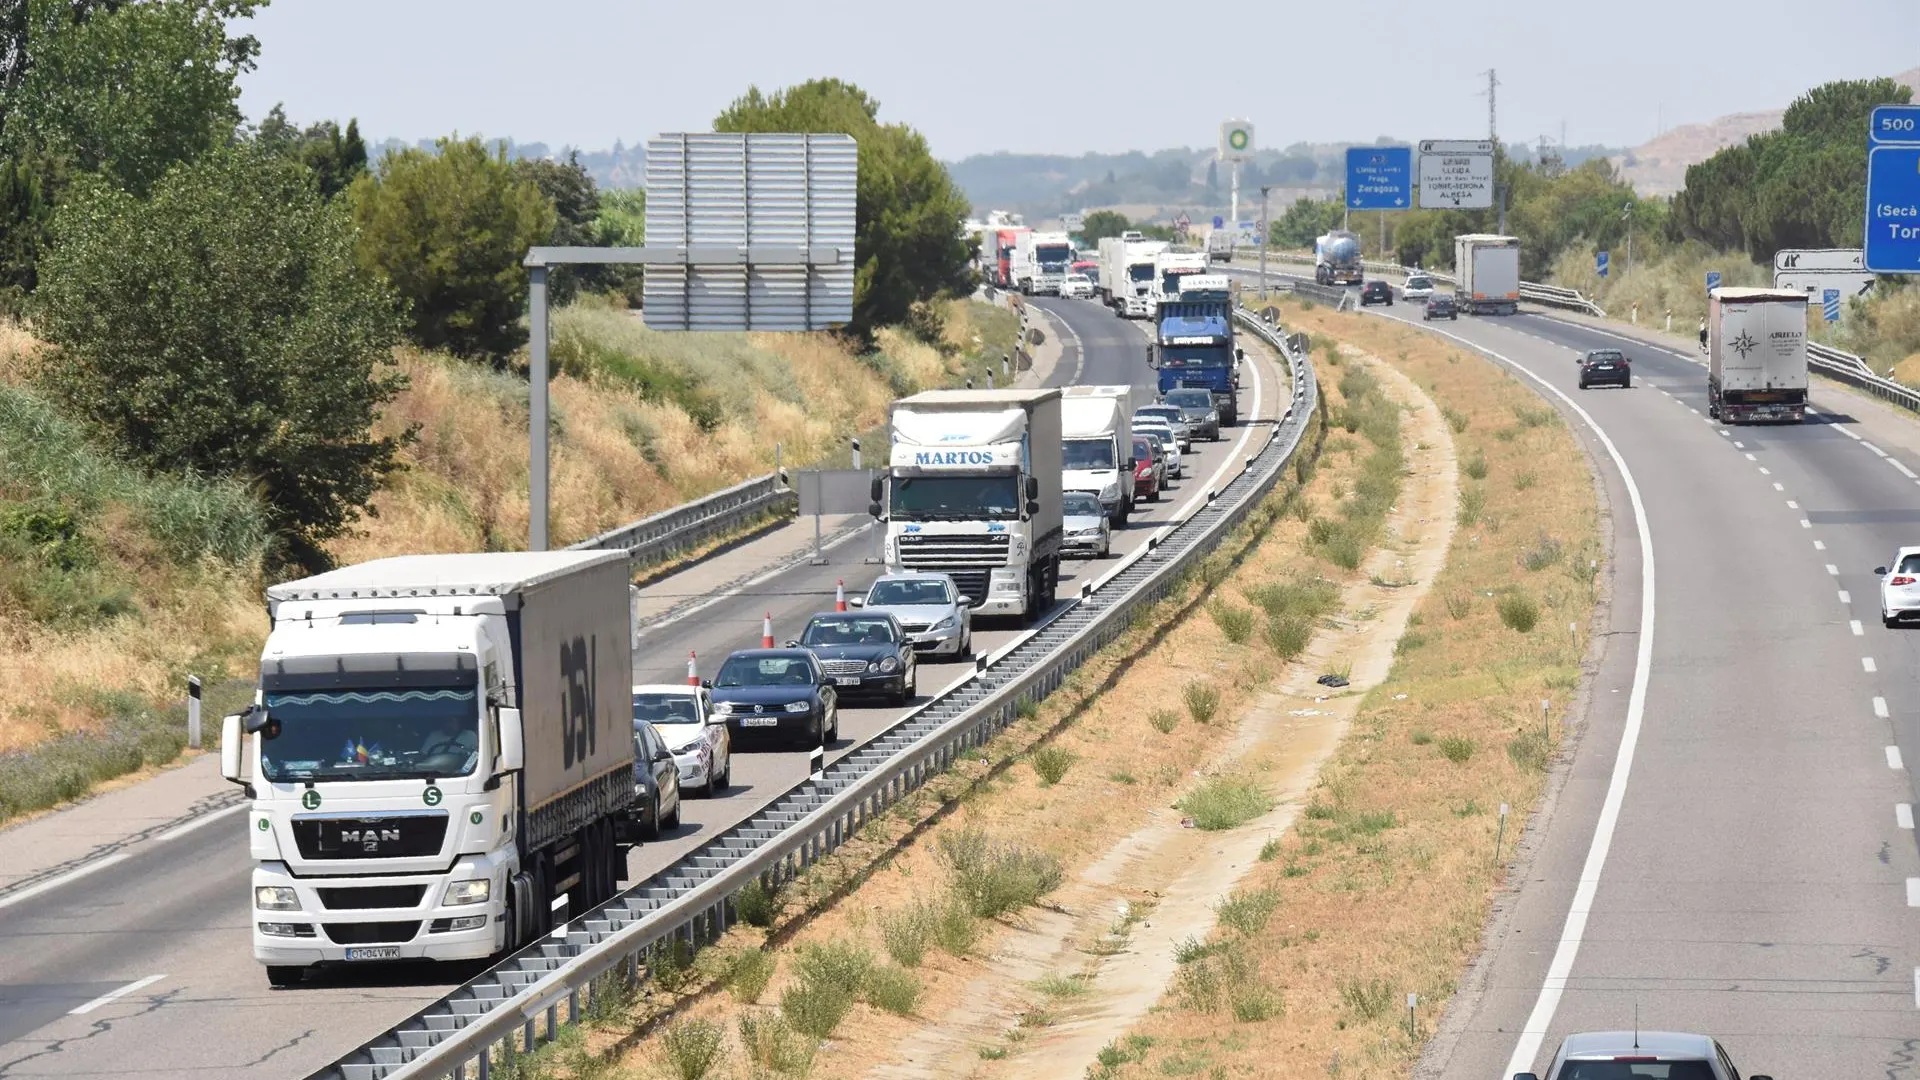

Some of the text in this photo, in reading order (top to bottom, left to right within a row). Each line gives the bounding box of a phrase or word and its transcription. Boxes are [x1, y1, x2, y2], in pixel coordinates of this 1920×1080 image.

[1881, 118, 1914, 131] 500
[1357, 184, 1400, 194] Zaragoza
[1877, 203, 1917, 218] (Secà
[915, 451, 993, 466] MARTOS
[341, 828, 400, 843] MAN
